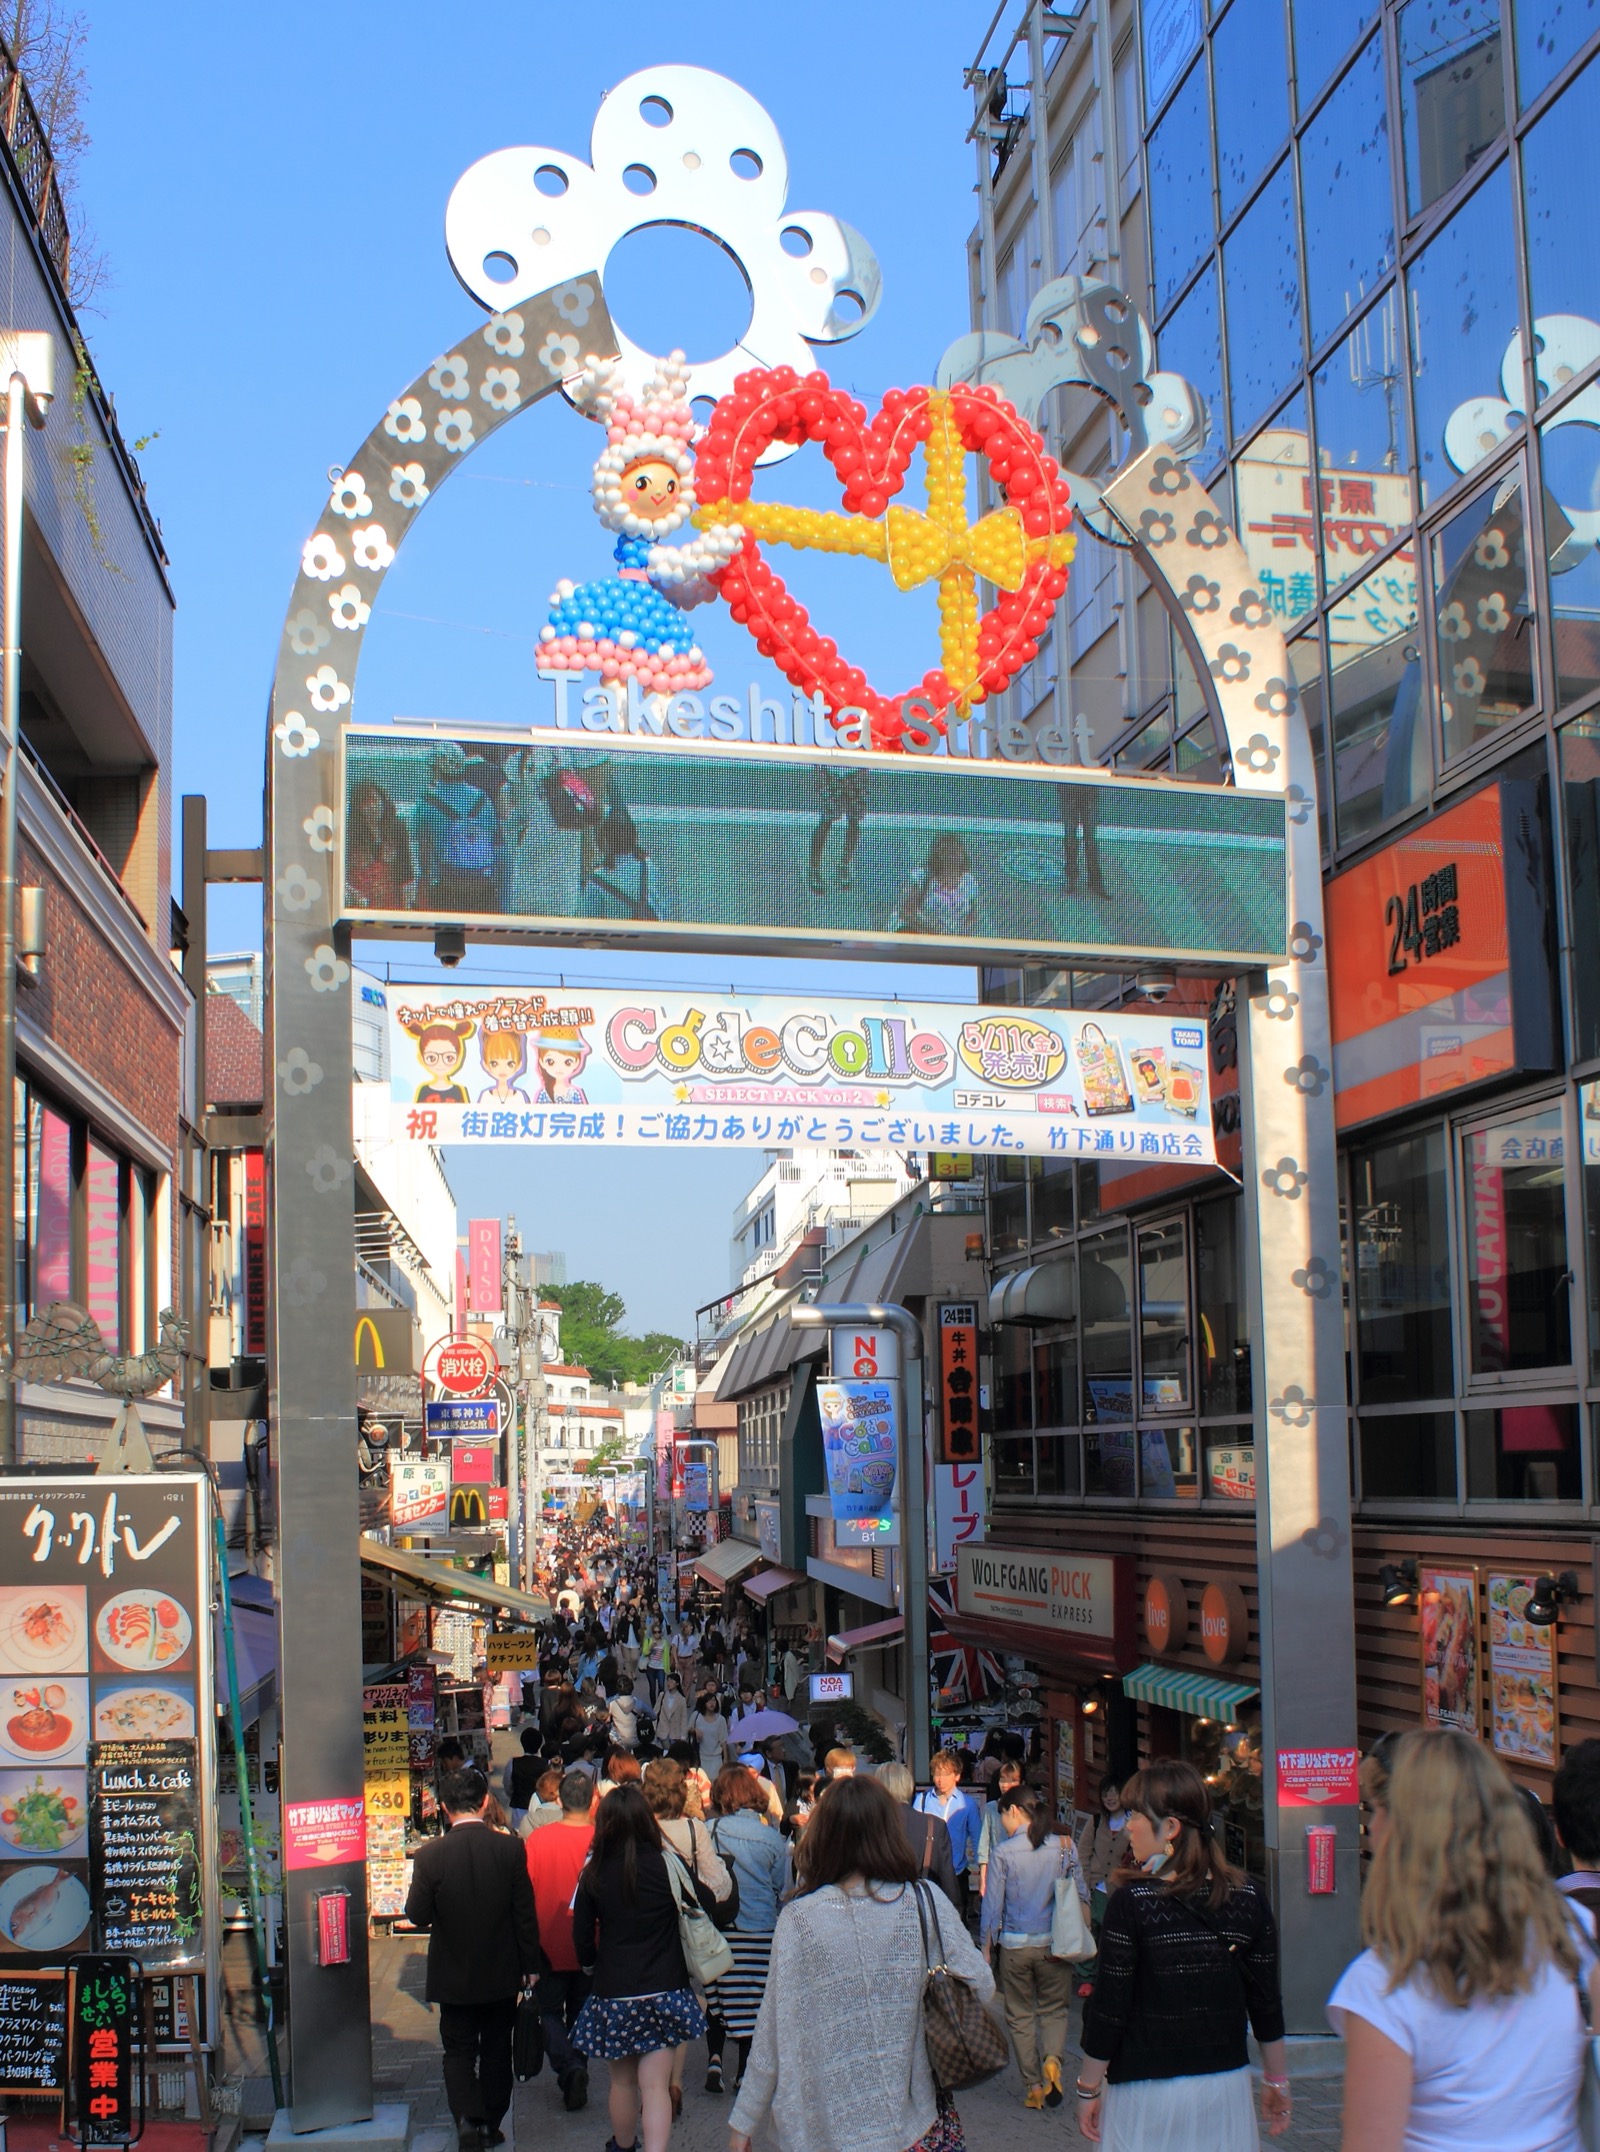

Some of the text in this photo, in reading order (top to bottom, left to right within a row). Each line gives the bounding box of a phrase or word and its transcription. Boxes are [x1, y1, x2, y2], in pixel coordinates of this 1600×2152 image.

[537, 668, 1102, 767] Takeshita Street
[1386, 885, 1424, 976] 24
[963, 1023, 1063, 1055] 5/11(金)
[1174, 1030, 1200, 1038] TAKARA
[1175, 1037, 1200, 1046] TOMY
[705, 1088, 862, 1104] SELECT PACK vol.2
[956, 1093, 1006, 1108] コデコレ
[1043, 1097, 1068, 1110] 検索
[407, 1109, 437, 1140] 祝
[1048, 1125, 1203, 1157] 竹下通り商店会
[939, 1163, 970, 1176] 3F
[248, 1178, 265, 1344] INTERNET CAFE
[479, 1229, 493, 1304] DAISO
[944, 1309, 957, 1324] 24
[952, 1331, 966, 1363] 牛丼
[441, 1357, 484, 1377] 消火栓
[853, 1336, 878, 1384] NO
[441, 1407, 485, 1418] 東郷神社
[441, 1420, 487, 1430] 東郷記念館
[403, 1467, 436, 1479] 原宿
[861, 1531, 875, 1542] B1
[971, 1558, 1091, 1600] WOLFGANG PUCK
[1051, 1604, 1093, 1624] EXPRESS
[1147, 1601, 1167, 1628] live
[1201, 1610, 1227, 1637] love
[489, 1640, 533, 1649] ハッピーワン
[820, 1677, 843, 1685] NOA
[820, 1684, 843, 1692] CAFE
[1279, 1751, 1355, 1769] 竹下通り公式マップ
[148, 1773, 160, 1787] &
[103, 1798, 134, 1812] 生ビール
[101, 1814, 162, 1828] 昔のオムライス
[288, 1801, 363, 1827] 竹下通り公式マップ
[291, 1824, 325, 1834] TAKESHITA
[325, 1822, 348, 1831] STREET
[130, 1892, 179, 1906] ケーキセット
[130, 1908, 180, 1922] 生ビールセット
[0, 2047, 44, 2063] パークリング
[89, 2029, 119, 2120] 営業中
